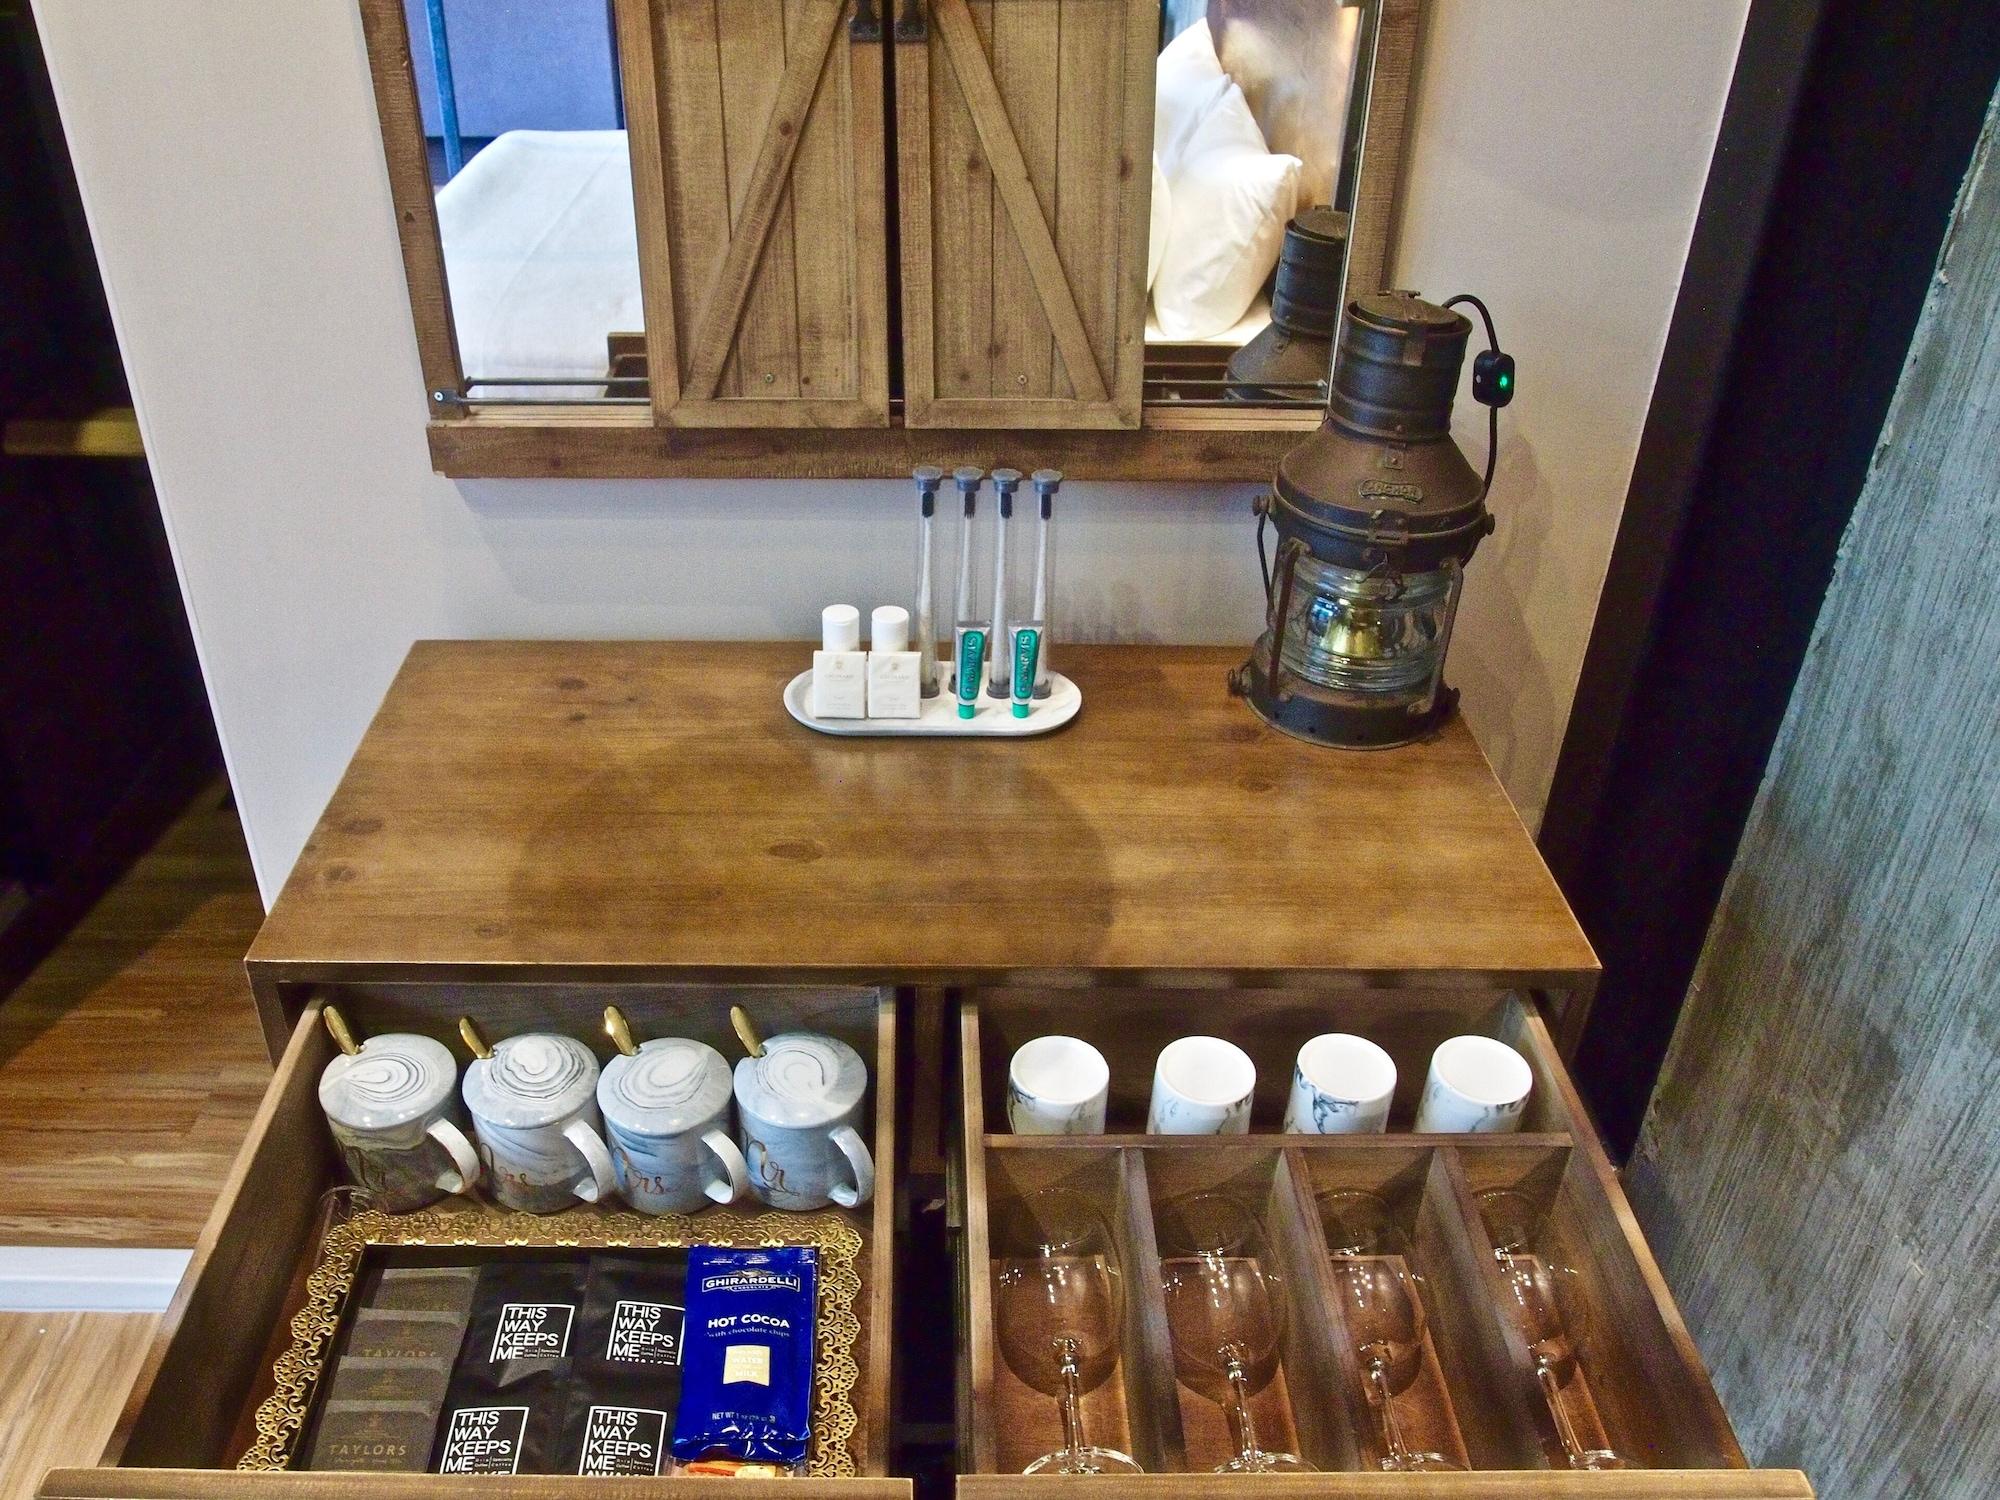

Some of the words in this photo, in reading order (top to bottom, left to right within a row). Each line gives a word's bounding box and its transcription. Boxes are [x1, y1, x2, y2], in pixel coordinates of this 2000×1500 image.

[705, 1277, 797, 1288] GHIRARDELLI
[508, 1307, 548, 1320] THIS
[621, 1304, 661, 1319] THIS
[504, 1320, 545, 1332] WAY
[619, 1317, 659, 1332] WAY
[708, 1316, 738, 1328] HOT
[741, 1314, 790, 1328] COCOA
[499, 1333, 559, 1346] KEEPS
[614, 1330, 674, 1347] KEEPS
[496, 1347, 525, 1360] ME
[612, 1343, 641, 1357] ME
[458, 1411, 500, 1426] THIS
[595, 1410, 638, 1426] THIS
[454, 1425, 497, 1441] WAY
[592, 1425, 636, 1440] WAY
[329, 1444, 407, 1456] TAYLORS
[449, 1440, 512, 1457] KEEPS
[589, 1439, 652, 1458] KEEPS
[445, 1456, 475, 1472] ME
[586, 1454, 616, 1470] ME
